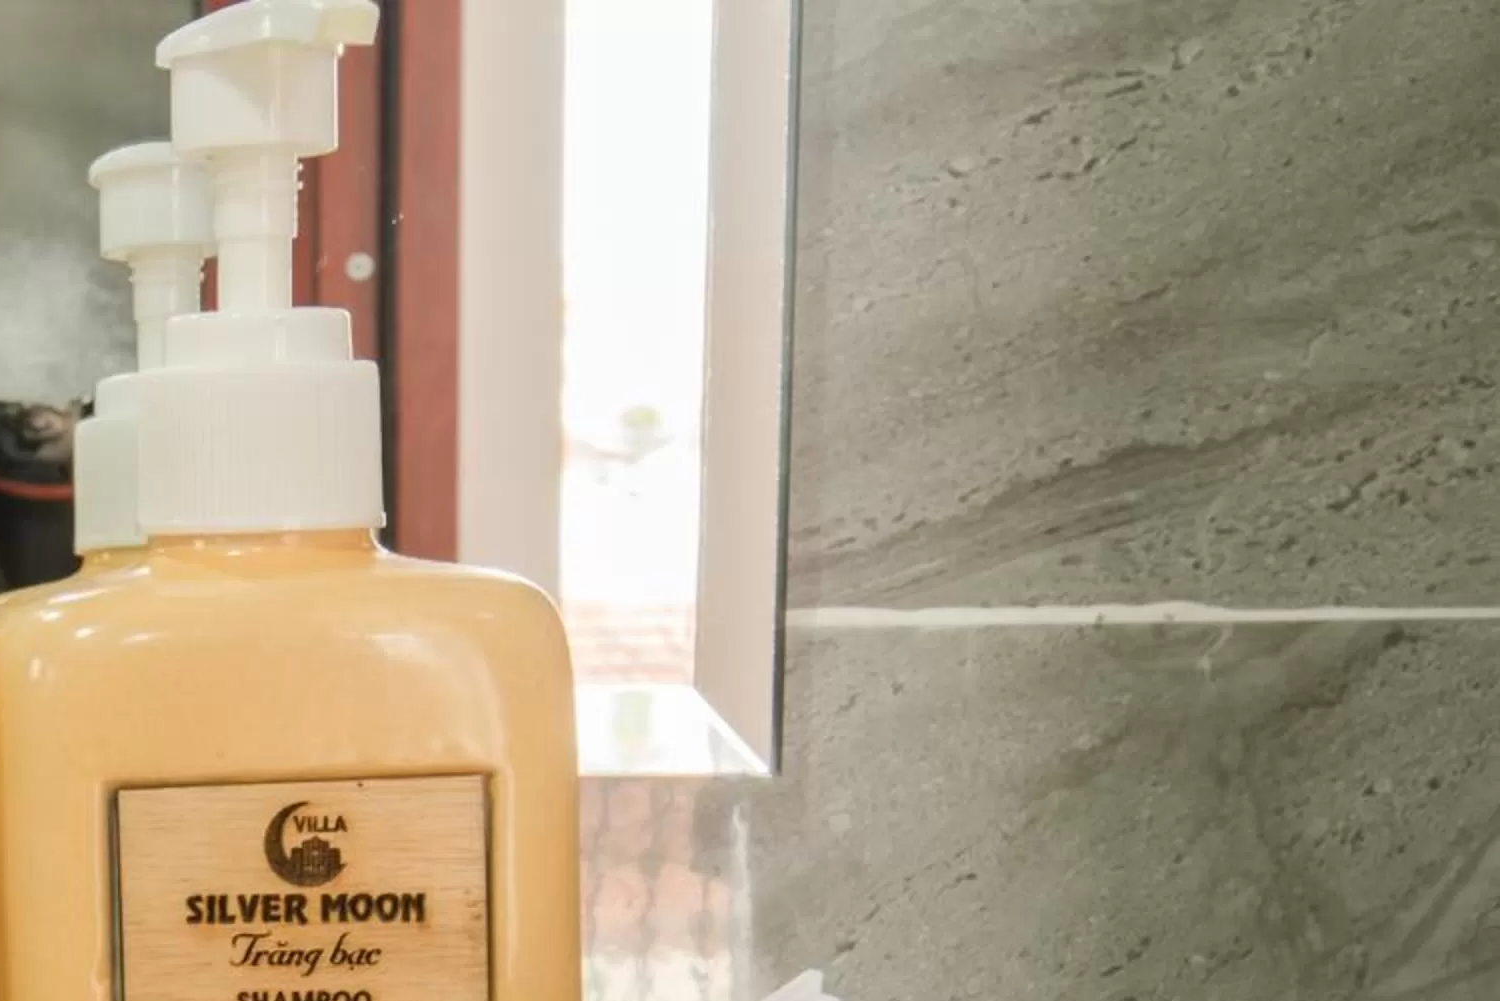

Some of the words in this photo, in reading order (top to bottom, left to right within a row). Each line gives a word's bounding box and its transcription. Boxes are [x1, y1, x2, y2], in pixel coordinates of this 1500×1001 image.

[292, 815, 348, 833] VILLA
[185, 893, 308, 925] SILVER
[320, 892, 426, 923] MOON
[230, 931, 326, 977] Trăng
[329, 931, 383, 971] bạc
